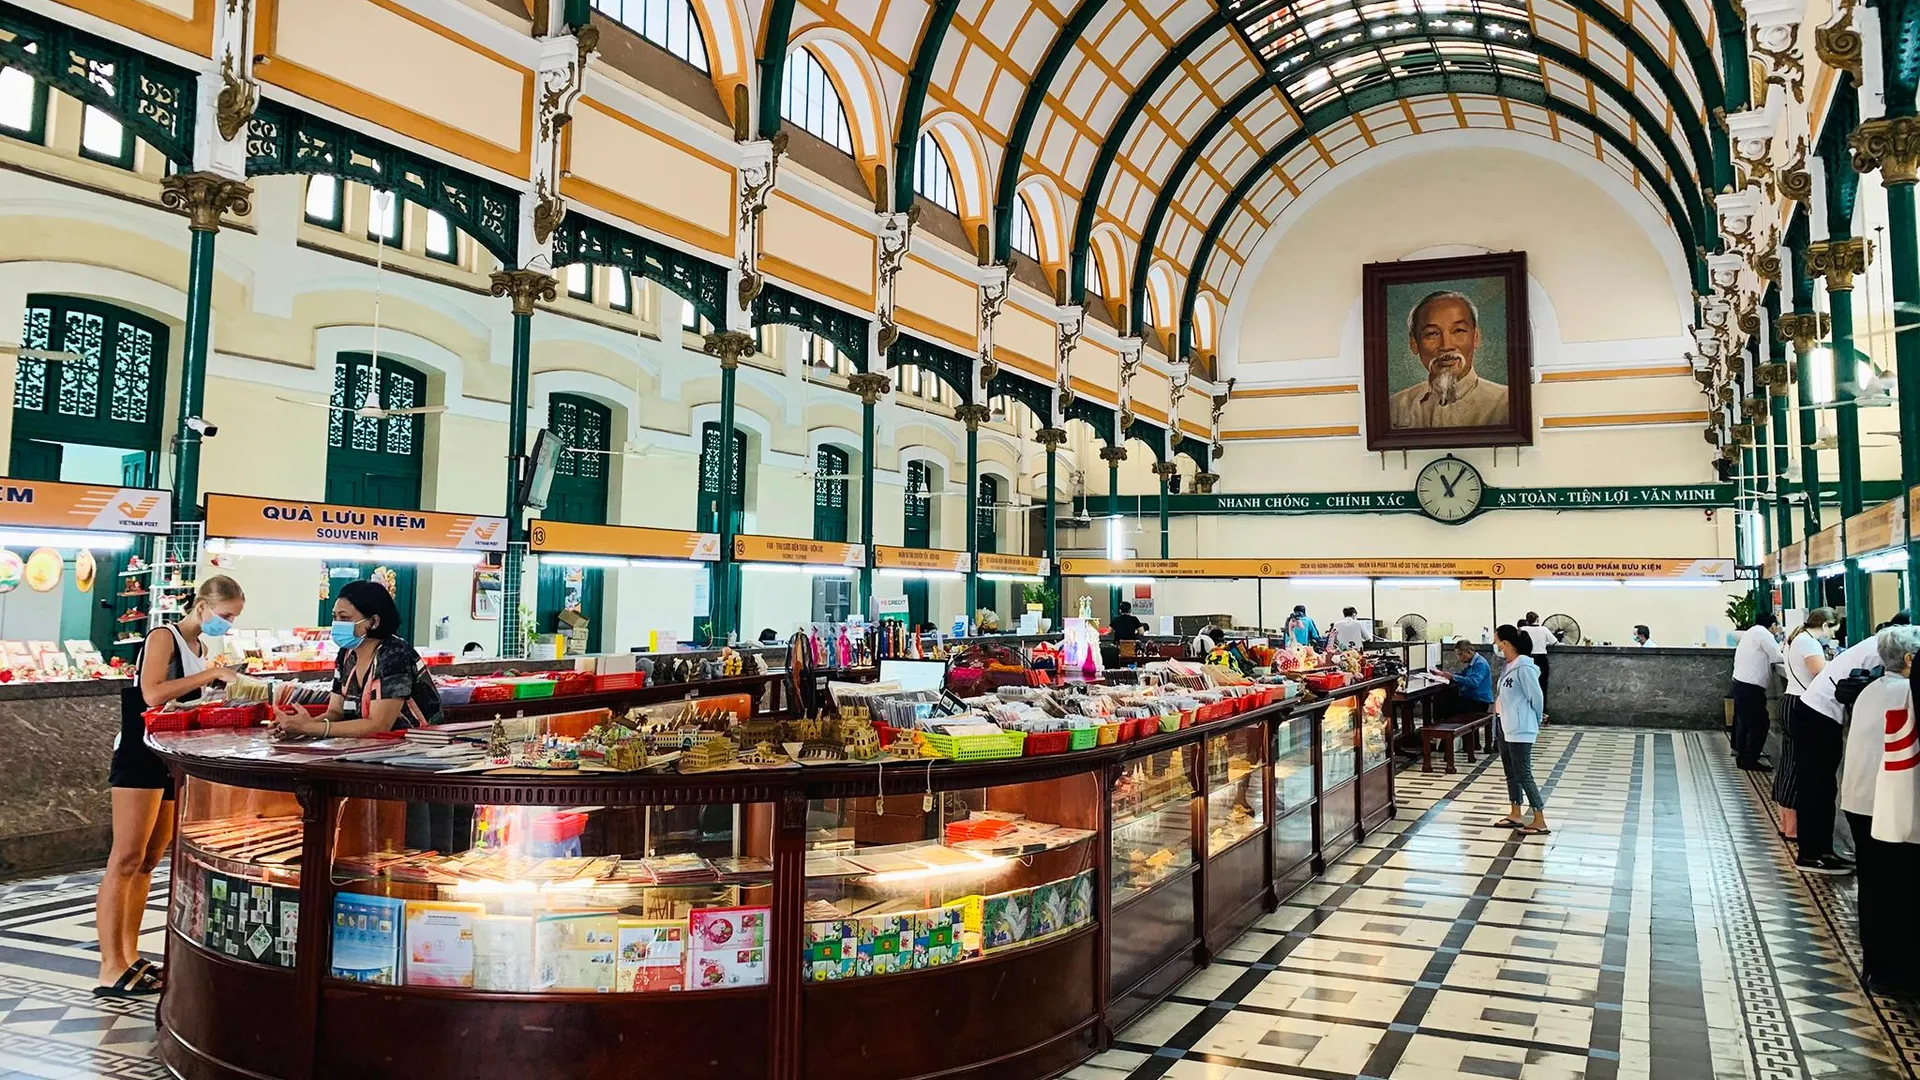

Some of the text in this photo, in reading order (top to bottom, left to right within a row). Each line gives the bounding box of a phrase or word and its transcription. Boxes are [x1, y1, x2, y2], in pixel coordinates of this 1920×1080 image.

[1218, 498, 1260, 508] NHANH
[1265, 494, 1309, 508] CHÓNG
[1326, 493, 1370, 507] CHÍNH
[1377, 492, 1405, 506] XÁC
[1519, 489, 1557, 503] TOÀN
[1567, 488, 1601, 505] TIỆN
[1605, 489, 1630, 504] LỢI
[1641, 487, 1671, 501] VĂN
[1675, 489, 1716, 500] MINH
[263, 504, 426, 531] QUÀ LƯU NIỆM
[316, 527, 379, 541] SOUVENIR
[535, 530, 543, 542] 13
[1263, 565, 1269, 573] 8
[1496, 565, 1501, 573] 7
